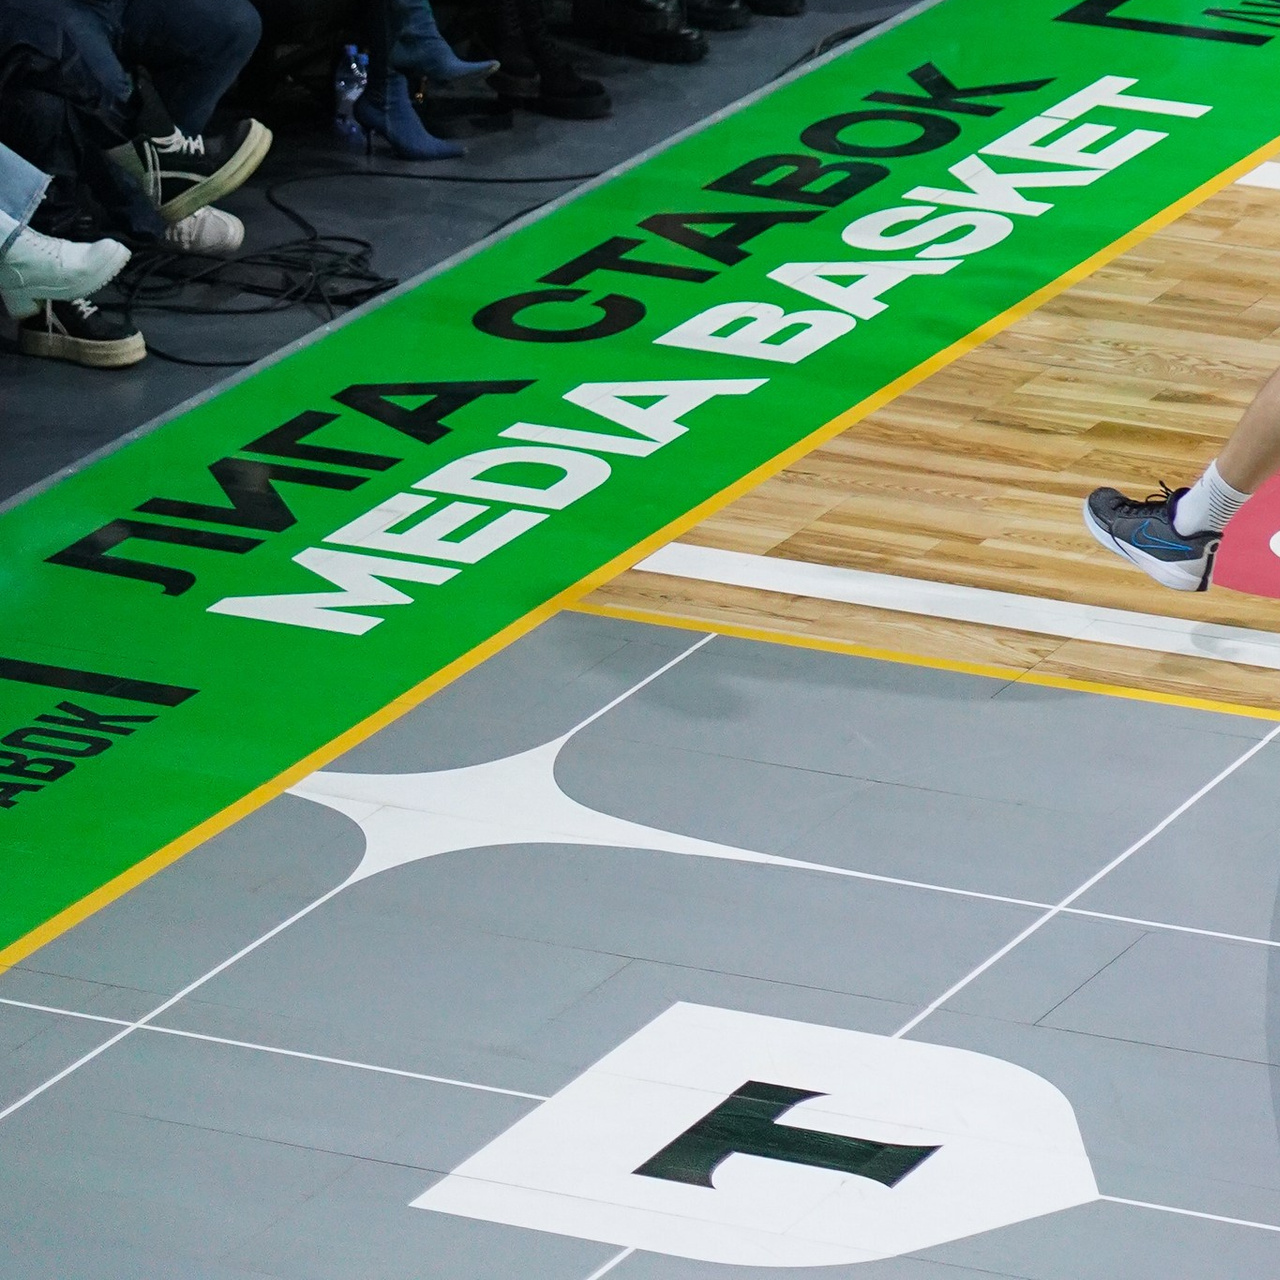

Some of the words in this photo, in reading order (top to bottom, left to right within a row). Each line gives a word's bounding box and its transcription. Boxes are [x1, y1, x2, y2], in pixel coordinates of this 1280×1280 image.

[45, 376, 538, 598] ЛИГА
[472, 61, 1058, 345] СТАВОК
[205, 377, 771, 637] MEDIA
[653, 75, 1214, 366] BASKET
